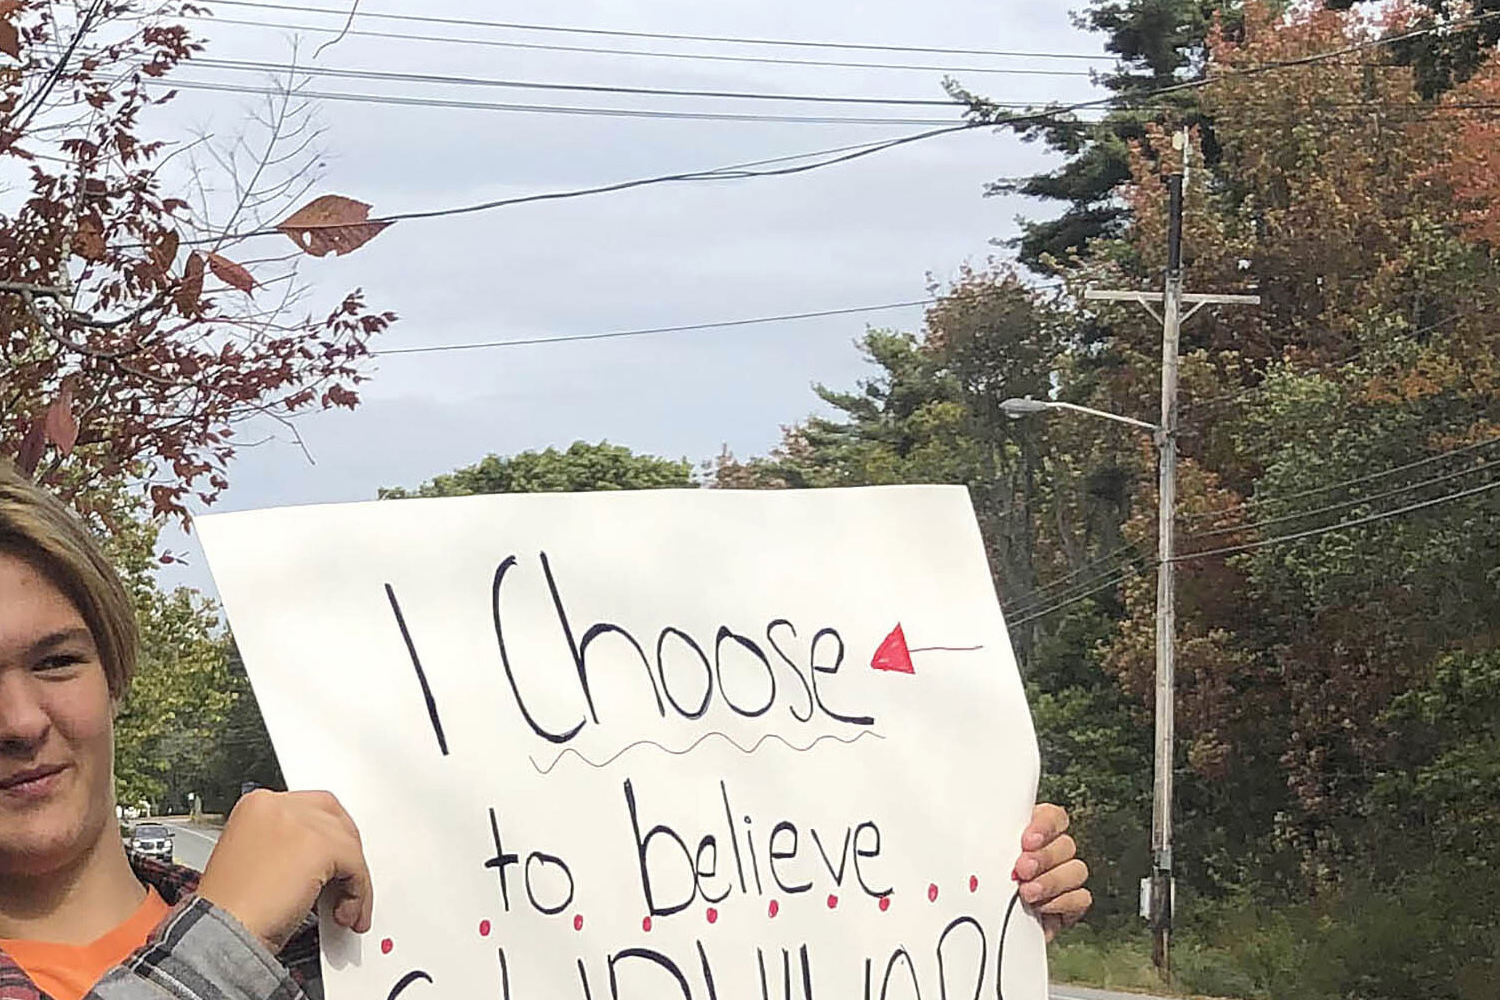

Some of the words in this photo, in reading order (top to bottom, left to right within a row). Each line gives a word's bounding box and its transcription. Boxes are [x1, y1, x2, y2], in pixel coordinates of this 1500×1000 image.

[385, 582, 448, 755] I
[492, 551, 875, 742] Choose
[484, 807, 574, 913] to
[624, 778, 894, 916] believe
